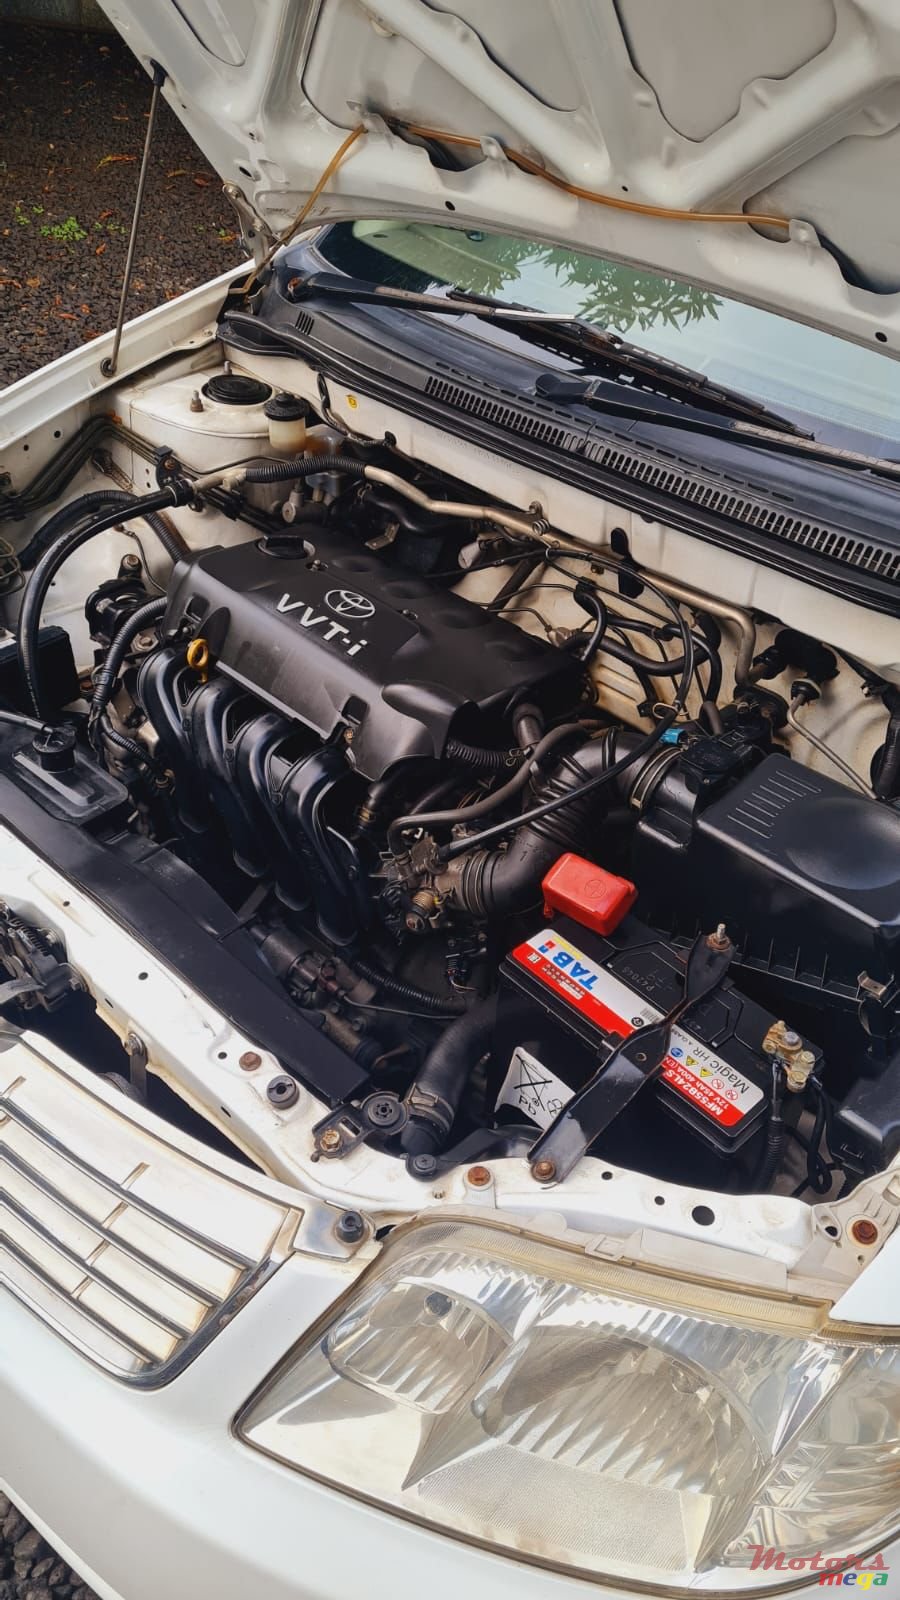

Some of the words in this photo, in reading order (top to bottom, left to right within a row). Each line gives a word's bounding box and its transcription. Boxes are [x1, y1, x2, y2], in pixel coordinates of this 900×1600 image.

[276, 593, 367, 656] VVT-i
[552, 950, 598, 990] TAB
[692, 1046, 710, 1061] HR
[676, 1066, 695, 1082] 400A
[709, 1059, 750, 1094] Magic
[665, 1069, 723, 1115] MF55B24LS
[695, 1081, 714, 1097] 45Ah
[518, 1095, 537, 1116] Pb
[713, 1096, 728, 1109] 12V
